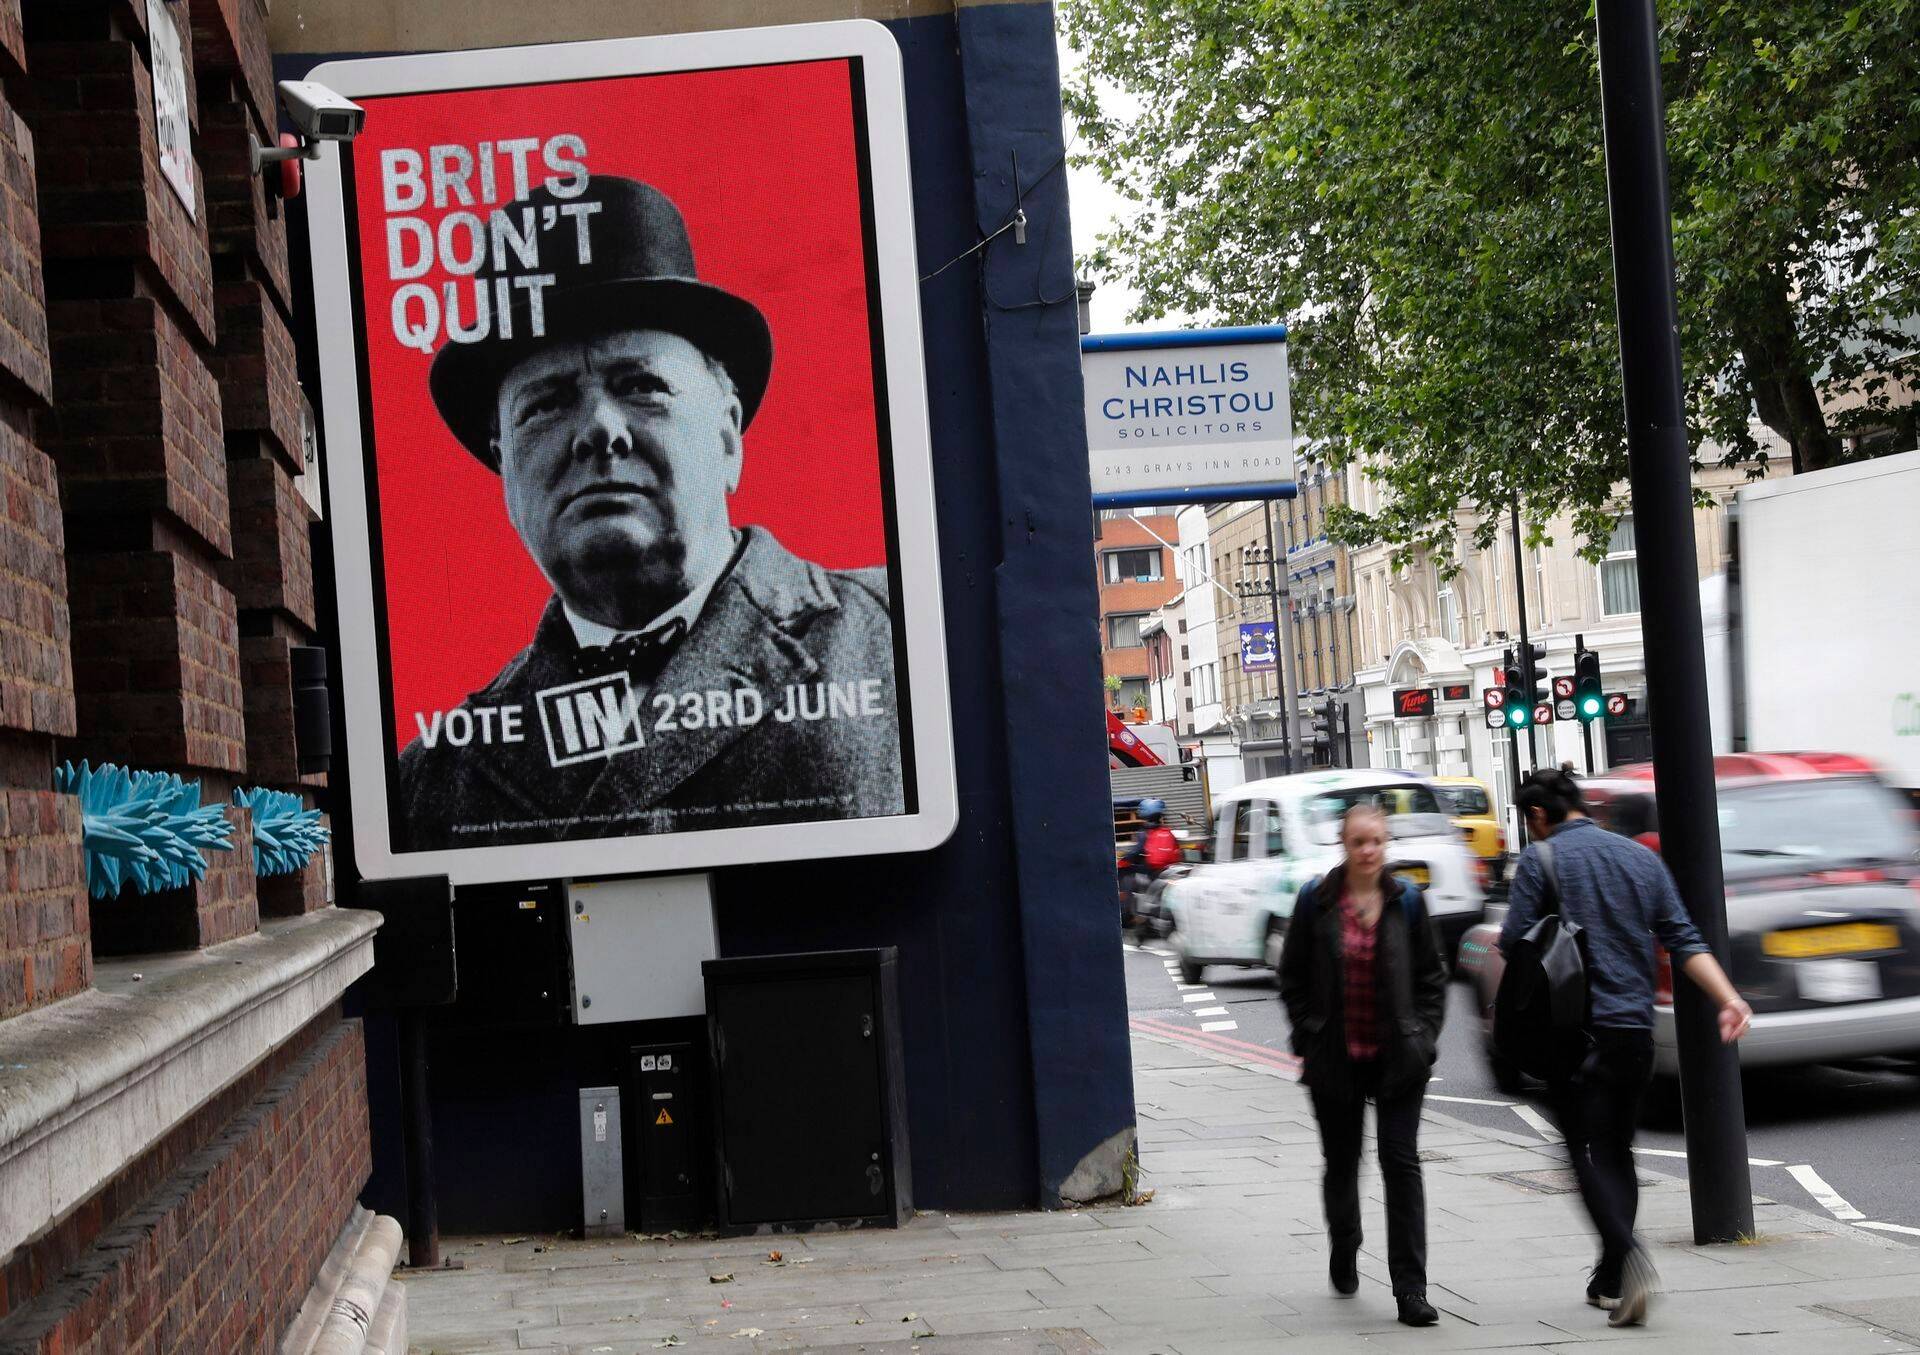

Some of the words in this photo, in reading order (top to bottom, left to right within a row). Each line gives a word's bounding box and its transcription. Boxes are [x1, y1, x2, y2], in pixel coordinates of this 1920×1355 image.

[380, 134, 589, 212] BRITS
[386, 201, 602, 280] DON'T
[391, 274, 556, 355] QUIT
[1126, 362, 1249, 388] NAHLIS
[1102, 391, 1274, 420] CHRISTOU
[1118, 421, 1262, 439] SOLICITORS
[1105, 465, 1132, 476] 243
[1144, 462, 1193, 474] GRAYS
[1205, 460, 1230, 470] INN
[1243, 457, 1281, 468] ROAD
[1400, 690, 1429, 712] Tune
[415, 705, 525, 749] VOTE
[556, 686, 624, 755] IN
[652, 687, 764, 732] 23RD
[775, 679, 884, 723] JUNE
